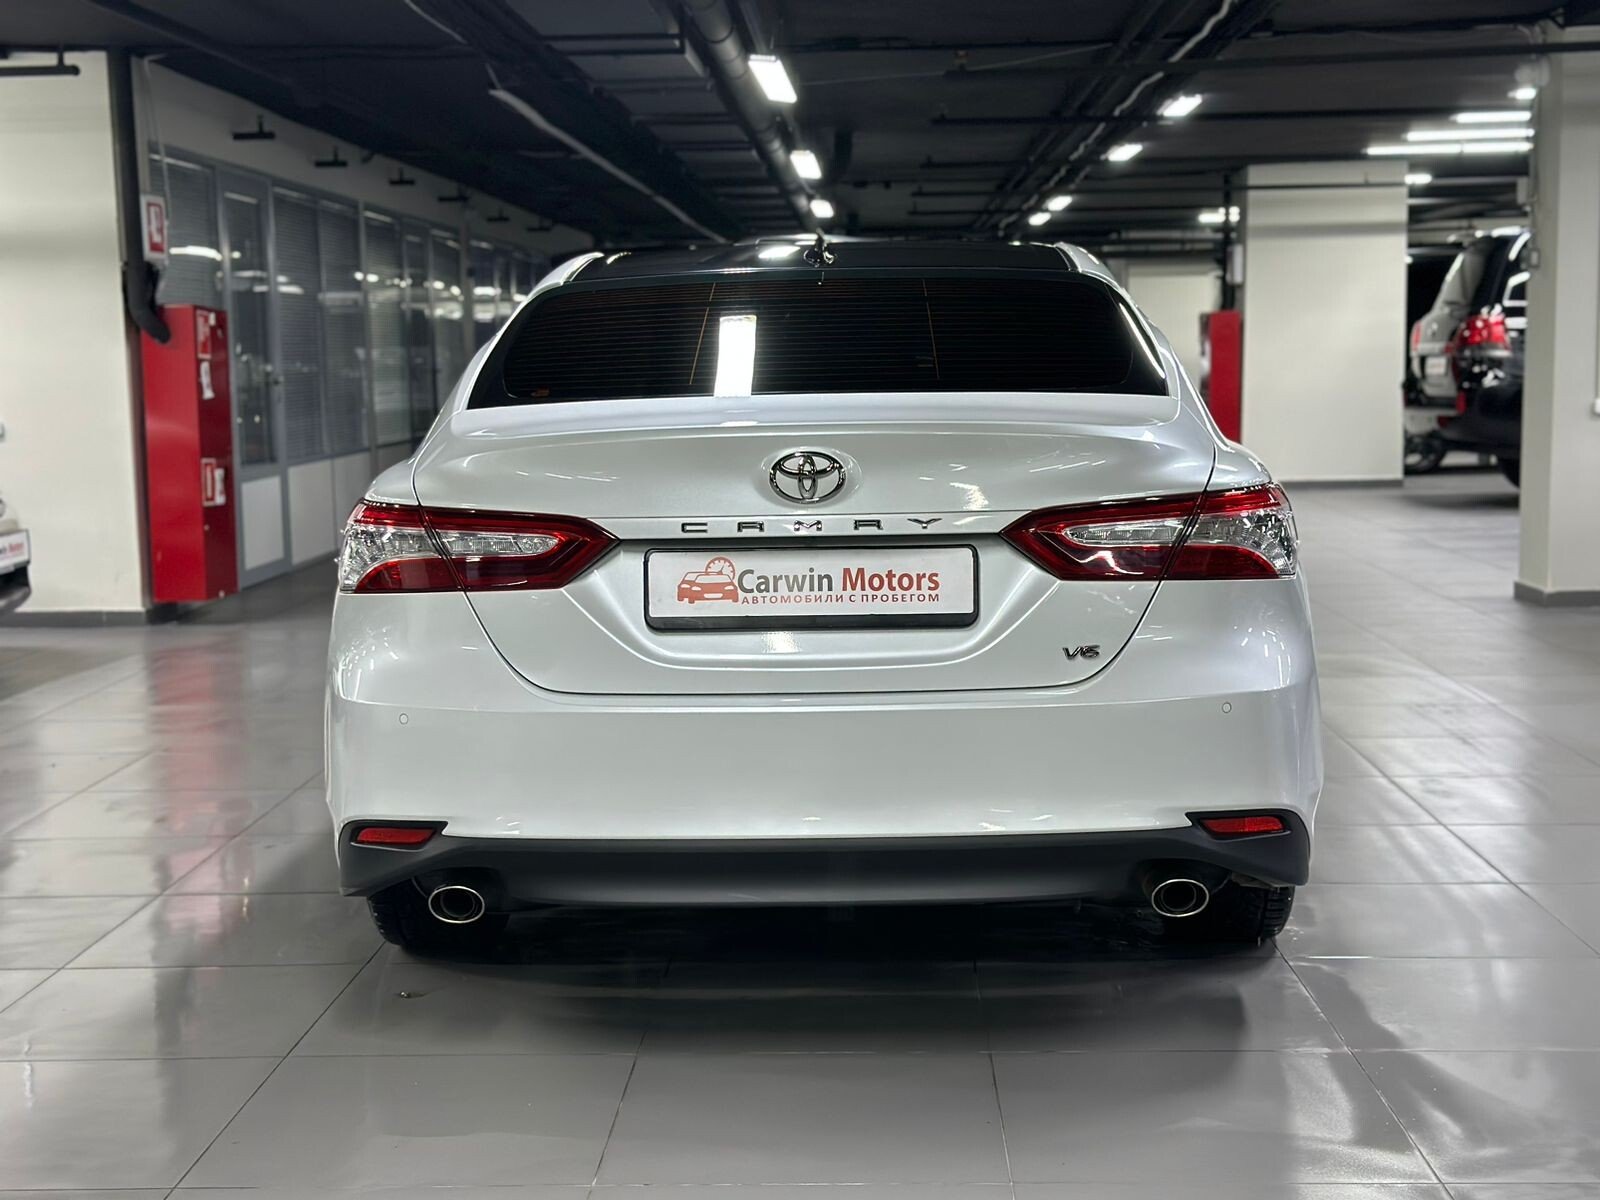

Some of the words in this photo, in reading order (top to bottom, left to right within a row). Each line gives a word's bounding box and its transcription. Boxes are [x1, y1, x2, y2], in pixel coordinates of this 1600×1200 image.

[681, 518, 942, 533] CAMRY
[737, 567, 833, 593] Carwin
[842, 567, 940, 592] Motors
[741, 594, 844, 605] АВТОМОБИЛИ
[848, 594, 856, 603] С
[861, 593, 940, 603] ПРОБЕГОМ
[1062, 645, 1100, 660] V6
